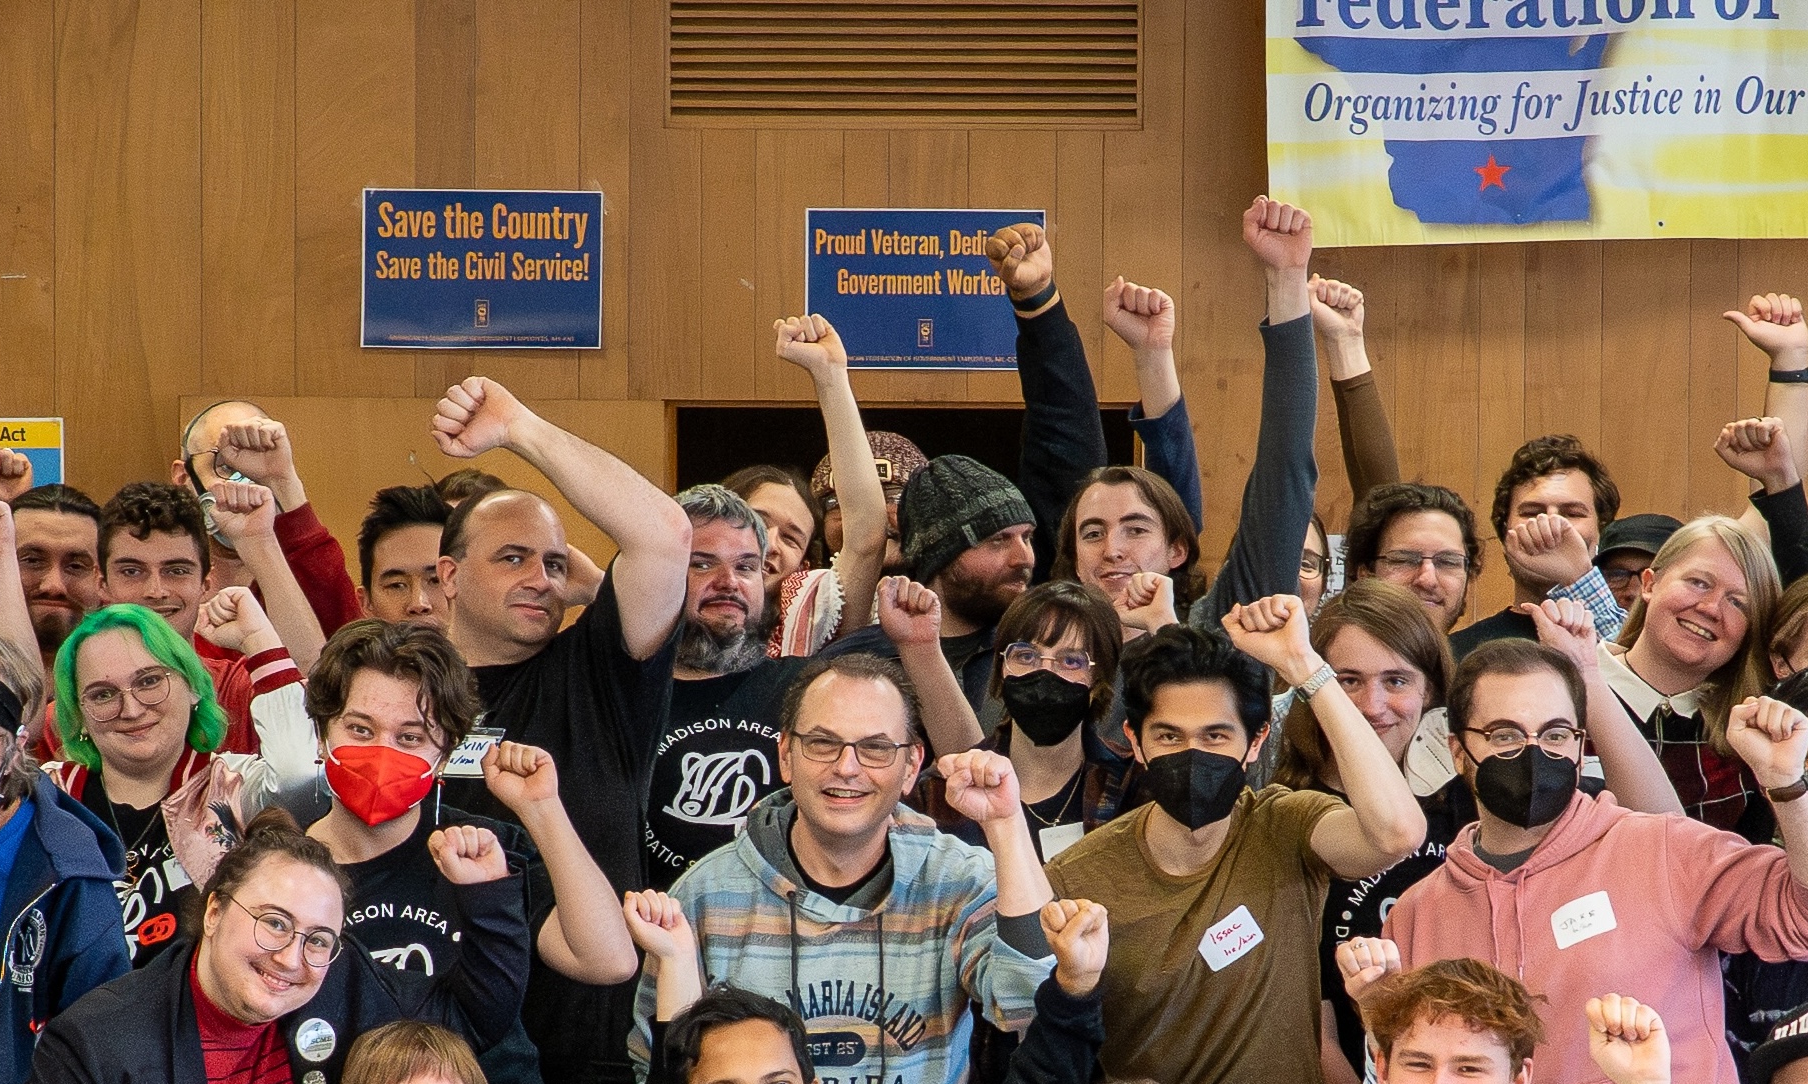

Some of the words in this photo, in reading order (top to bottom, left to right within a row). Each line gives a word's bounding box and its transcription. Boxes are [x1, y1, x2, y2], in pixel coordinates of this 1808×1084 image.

[1303, 81, 1502, 136] Organizing
[1504, 81, 1562, 136] for
[1563, 74, 1684, 133] Justice
[1693, 73, 1722, 115] in
[1734, 75, 1806, 116] Our
[377, 201, 436, 239] Save
[443, 202, 484, 240] the
[492, 202, 589, 249] Country
[815, 228, 866, 255] Proud
[871, 229, 945, 260] Veteran,
[375, 250, 422, 280] Save
[427, 251, 459, 281] the
[464, 251, 506, 281] Civil
[511, 252, 590, 281] Service!
[837, 268, 942, 295] Government
[0, 426, 27, 443] Act
[656, 718, 731, 756] MADISON
[736, 719, 783, 743] AREA
[400, 904, 449, 936] AREA
[856, 983, 927, 1052] ISLAND
